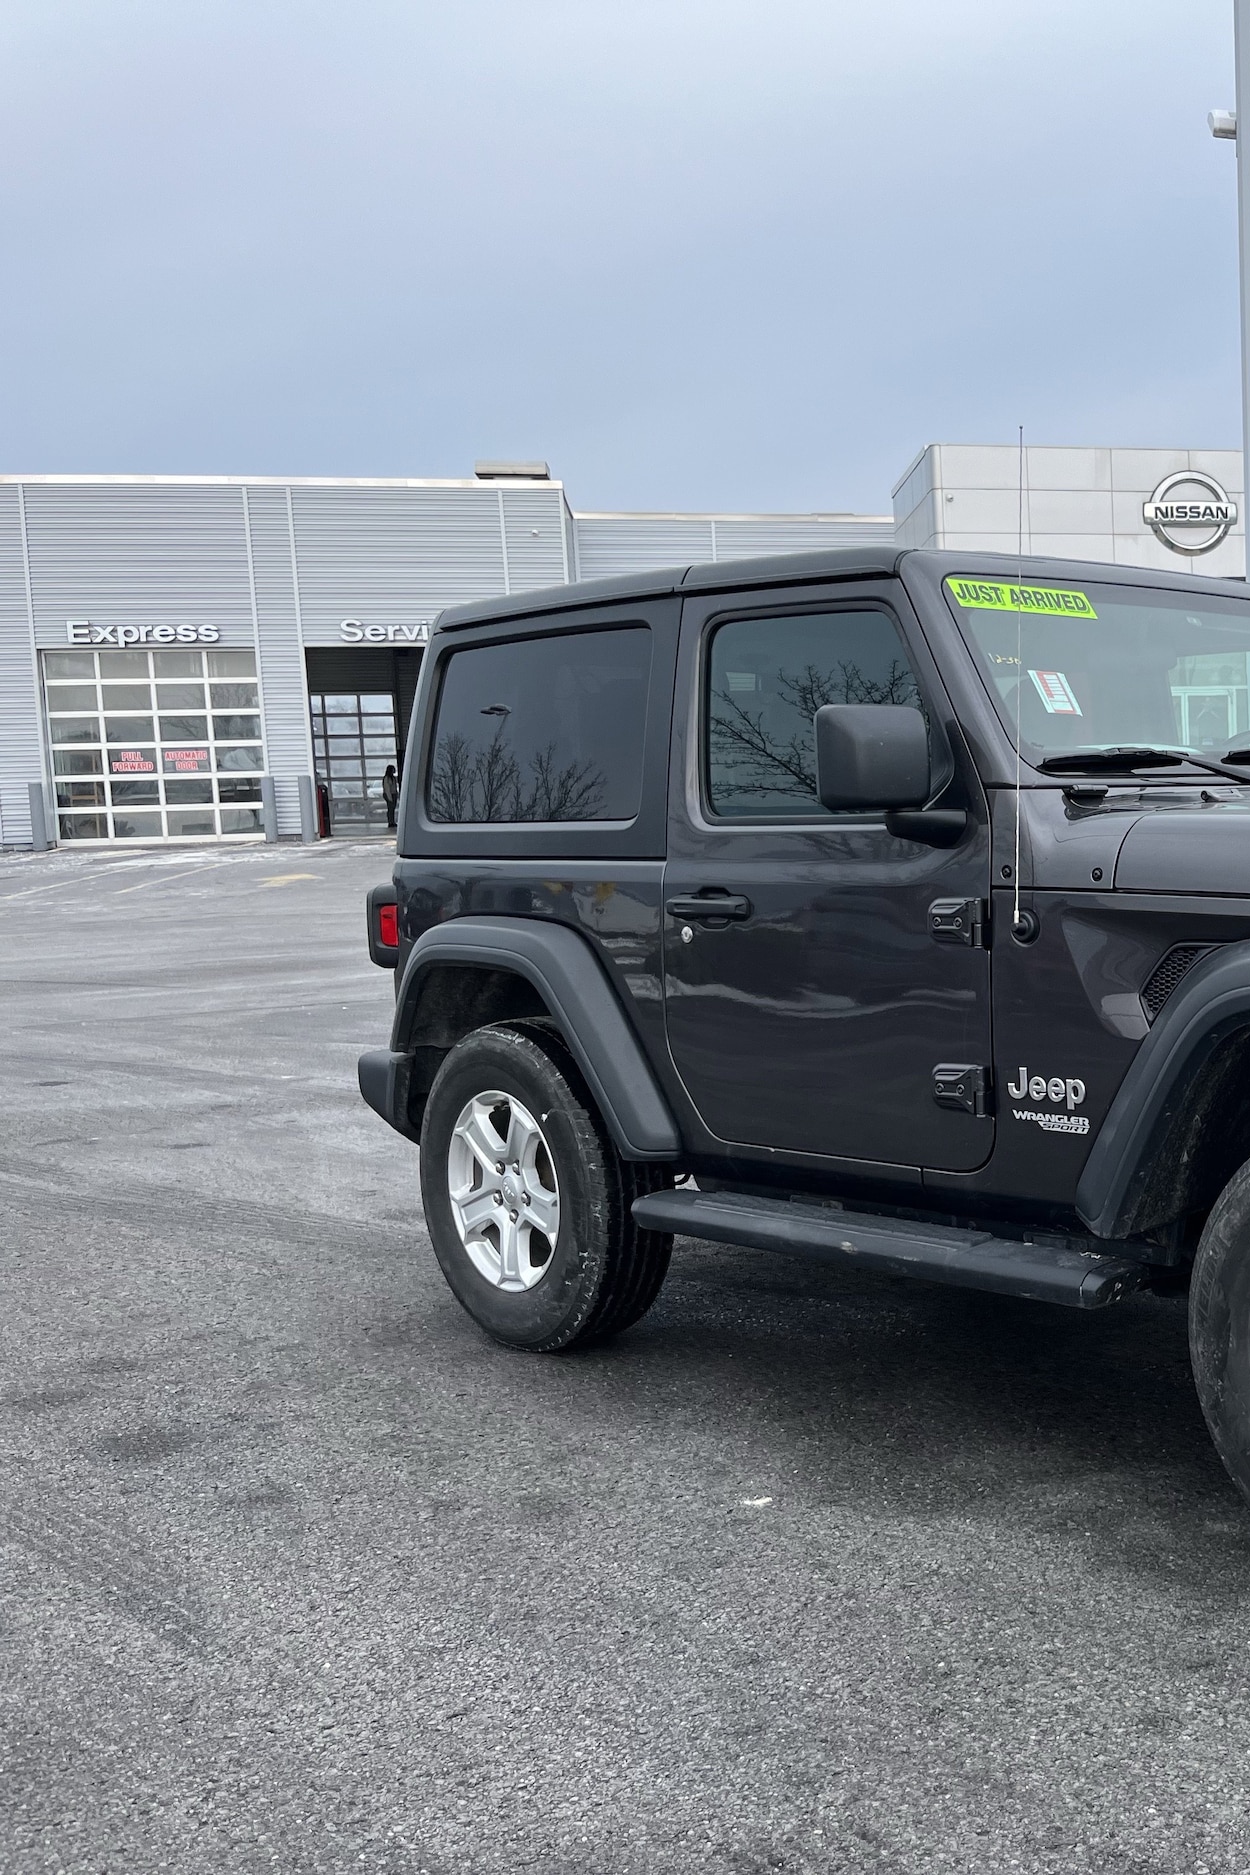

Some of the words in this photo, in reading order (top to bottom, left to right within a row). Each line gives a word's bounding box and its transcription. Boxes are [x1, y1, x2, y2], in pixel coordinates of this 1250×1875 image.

[1154, 505, 1229, 520] NISSAN
[956, 583, 1005, 606] JUST
[1009, 588, 1091, 613] ARRIVED
[66, 620, 220, 648] Express
[121, 752, 143, 761] PULL
[165, 751, 207, 760] AUTOMATIC
[112, 762, 154, 771] FORWARD
[176, 761, 198, 770] DOOR
[1007, 1067, 1086, 1110] Jeep
[1012, 1109, 1090, 1127] WRANGLER
[1041, 1122, 1088, 1133] SPORT
